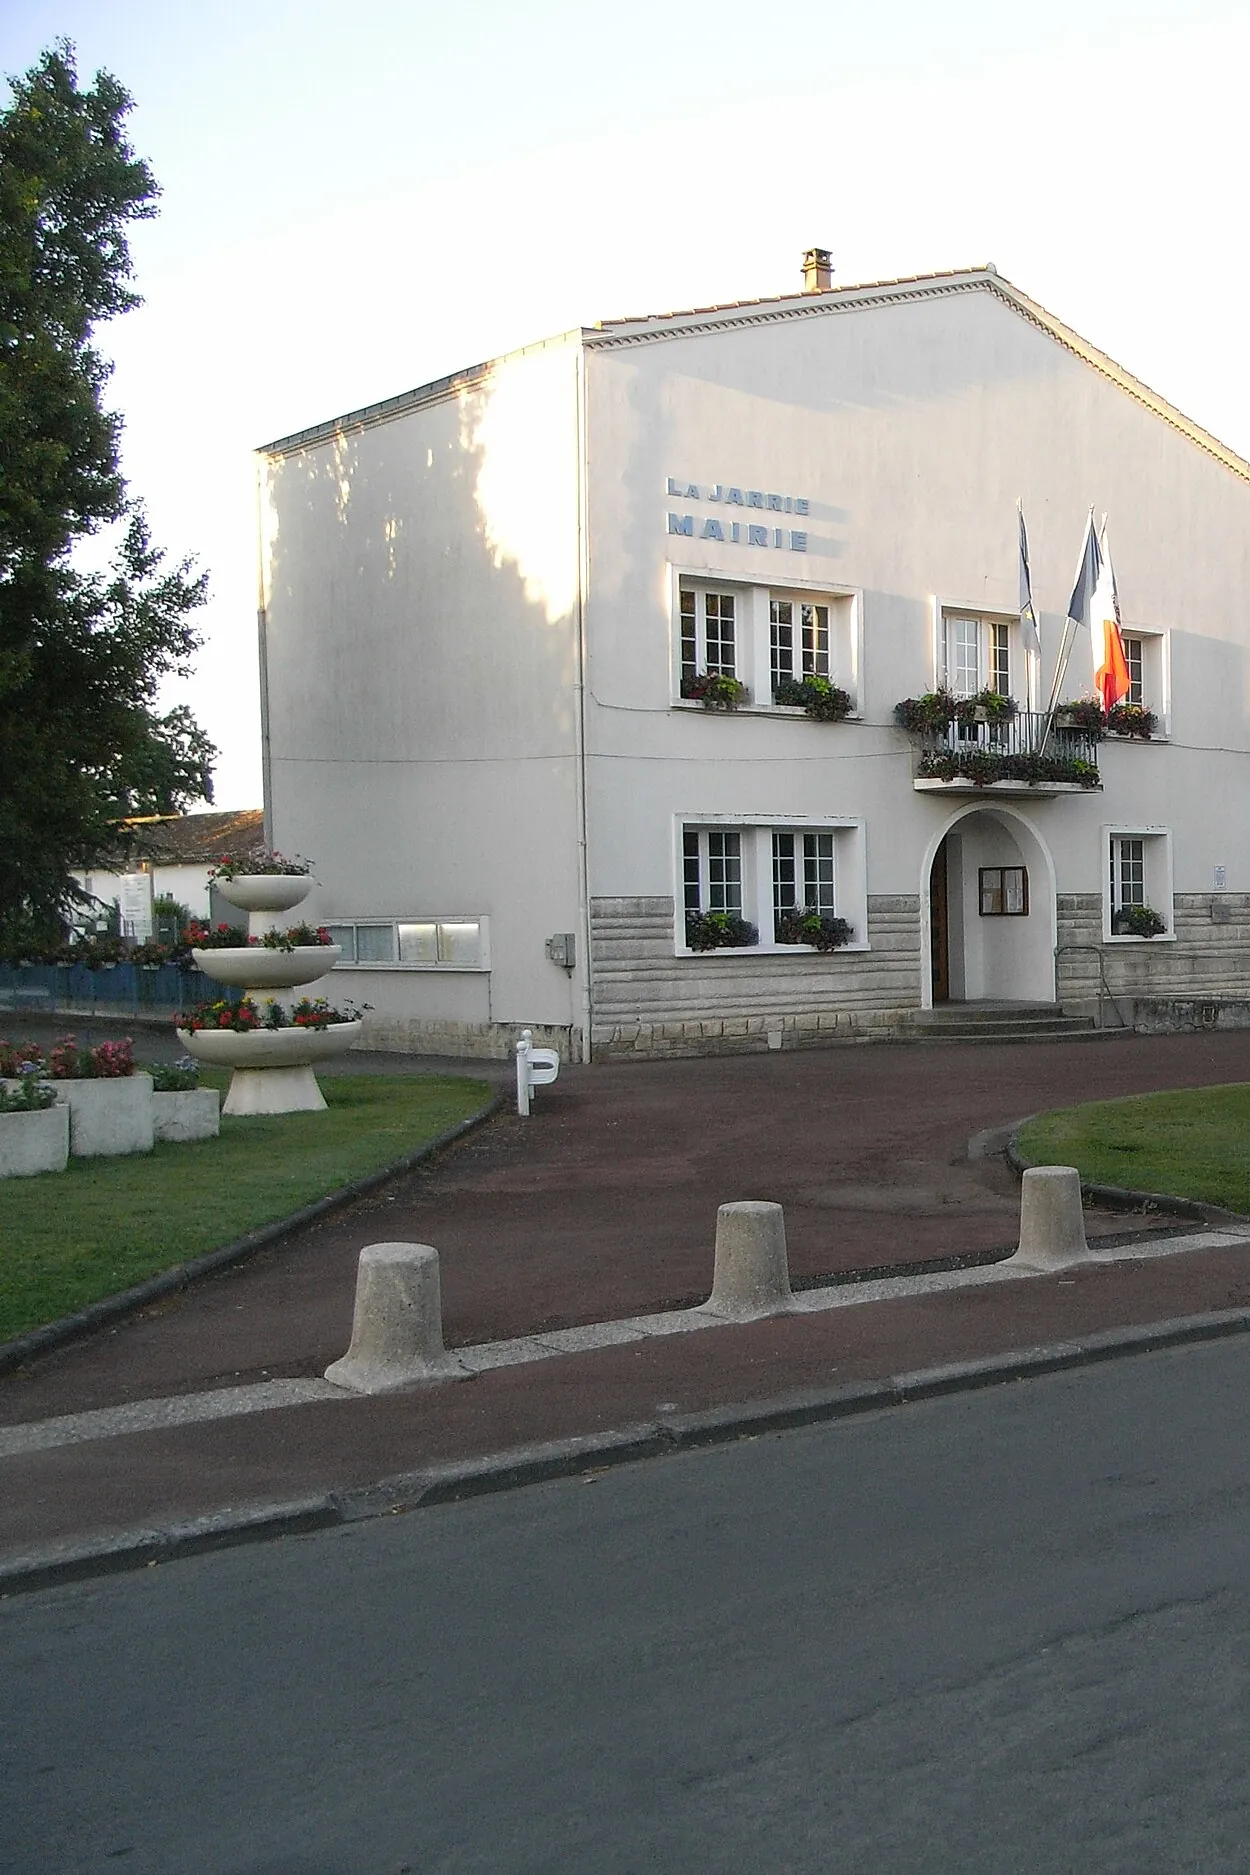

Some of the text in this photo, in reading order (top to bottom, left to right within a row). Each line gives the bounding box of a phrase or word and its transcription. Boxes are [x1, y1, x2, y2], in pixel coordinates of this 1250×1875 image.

[666, 476, 810, 516] LA JARRIE
[666, 511, 808, 552] MAIRIE
